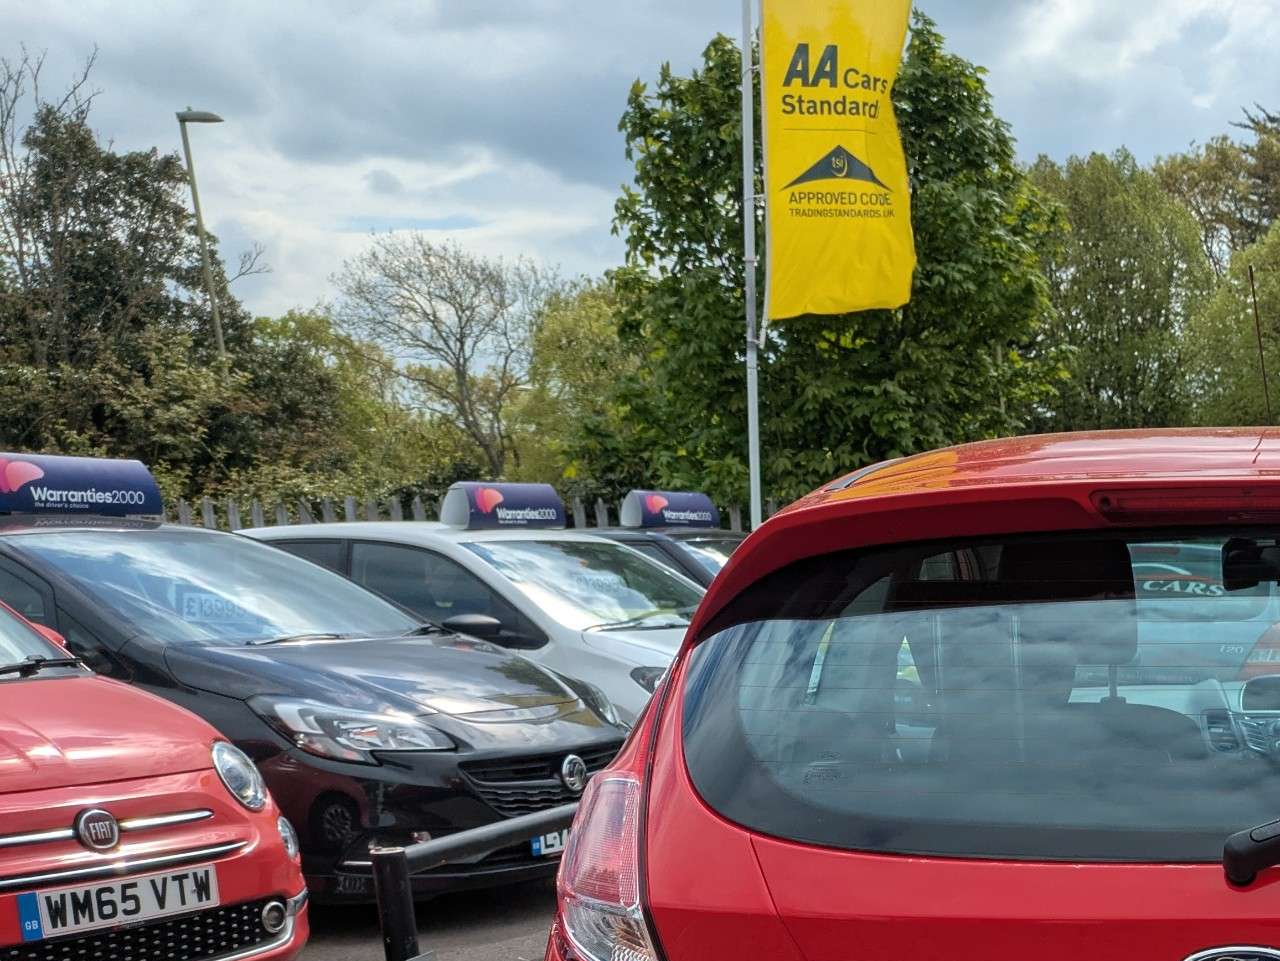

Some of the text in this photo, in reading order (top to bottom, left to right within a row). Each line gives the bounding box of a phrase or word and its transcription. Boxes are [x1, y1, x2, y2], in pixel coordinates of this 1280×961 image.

[782, 42, 888, 94] AA Cars
[781, 94, 879, 119] Standard
[788, 191, 893, 206] APPROVED CODE
[30, 486, 145, 505] Warranties2000
[1142, 579, 1225, 597] CARS
[89, 821, 112, 840] FIAT
[45, 869, 212, 929] WM65 VTW
[25, 920, 39, 931] GB
